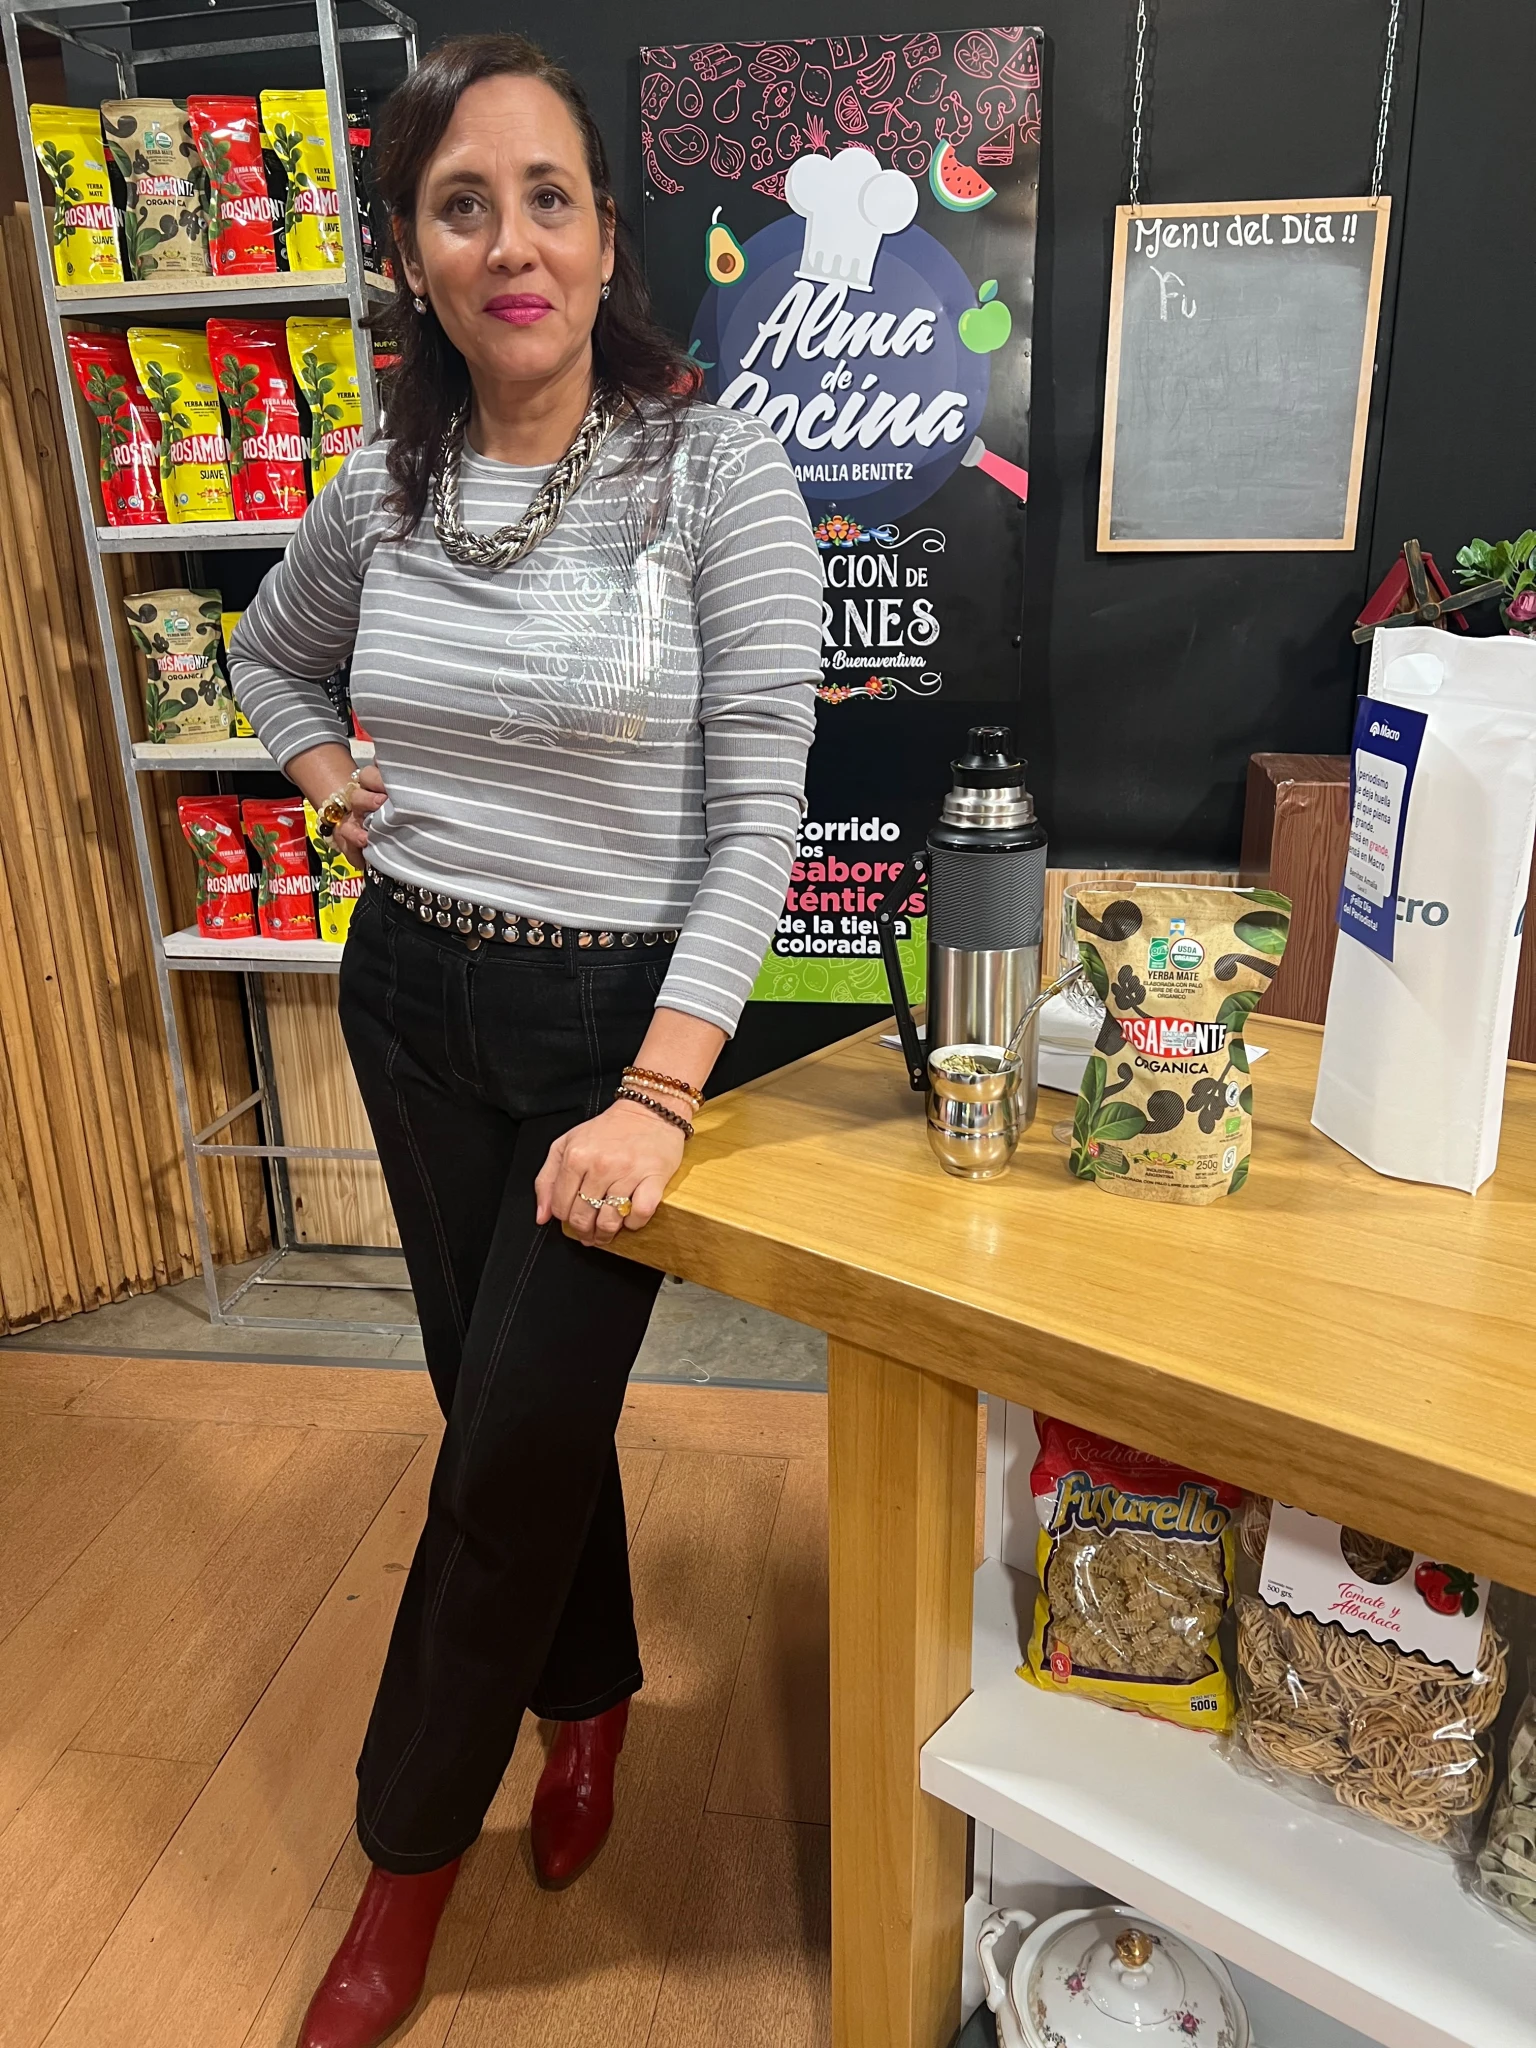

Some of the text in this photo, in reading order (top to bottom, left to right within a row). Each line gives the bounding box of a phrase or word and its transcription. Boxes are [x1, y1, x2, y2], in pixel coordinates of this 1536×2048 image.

[221, 196, 285, 220] ROSAMONT
[92, 236, 115, 245] SUAVE
[1134, 218, 1219, 258] Menu
[1226, 213, 1273, 247] del
[739, 279, 937, 369] Alma
[820, 358, 854, 392] de
[243, 433, 312, 460] ROSAMON
[200, 469, 224, 480] SUAVE
[794, 462, 914, 482] AMALIA BENITEZ
[905, 567, 928, 588] DE
[832, 650, 927, 670] Buenaventura
[167, 673, 203, 681] ORGANICA
[1380, 724, 1400, 741] Macro
[1358, 770, 1389, 790] periodismo
[1362, 786, 1374, 802] deja
[1374, 790, 1391, 808] huella
[1356, 801, 1362, 811] el
[1362, 803, 1373, 816] que
[1372, 807, 1391, 825] piensa
[1362, 836, 1369, 847] en
[1361, 851, 1368, 861] en
[1368, 853, 1385, 872] Macro
[786, 885, 926, 914] téntics
[1343, 902, 1352, 915] del
[776, 914, 806, 935] de
[813, 914, 834, 935] la
[776, 934, 881, 955] colorada
[1178, 945, 1197, 954] USDA
[1148, 970, 1200, 981] YERBA MATE
[1134, 1055, 1209, 1075] ORGANICA
[1196, 1159, 1218, 1171] 250g
[1267, 1583, 1280, 1594] 500
[1280, 1590, 1294, 1599] grs.
[1338, 1582, 1401, 1619] Tomate y
[1327, 1599, 1402, 1633] Albahaca
[1190, 1699, 1218, 1712] 500g
